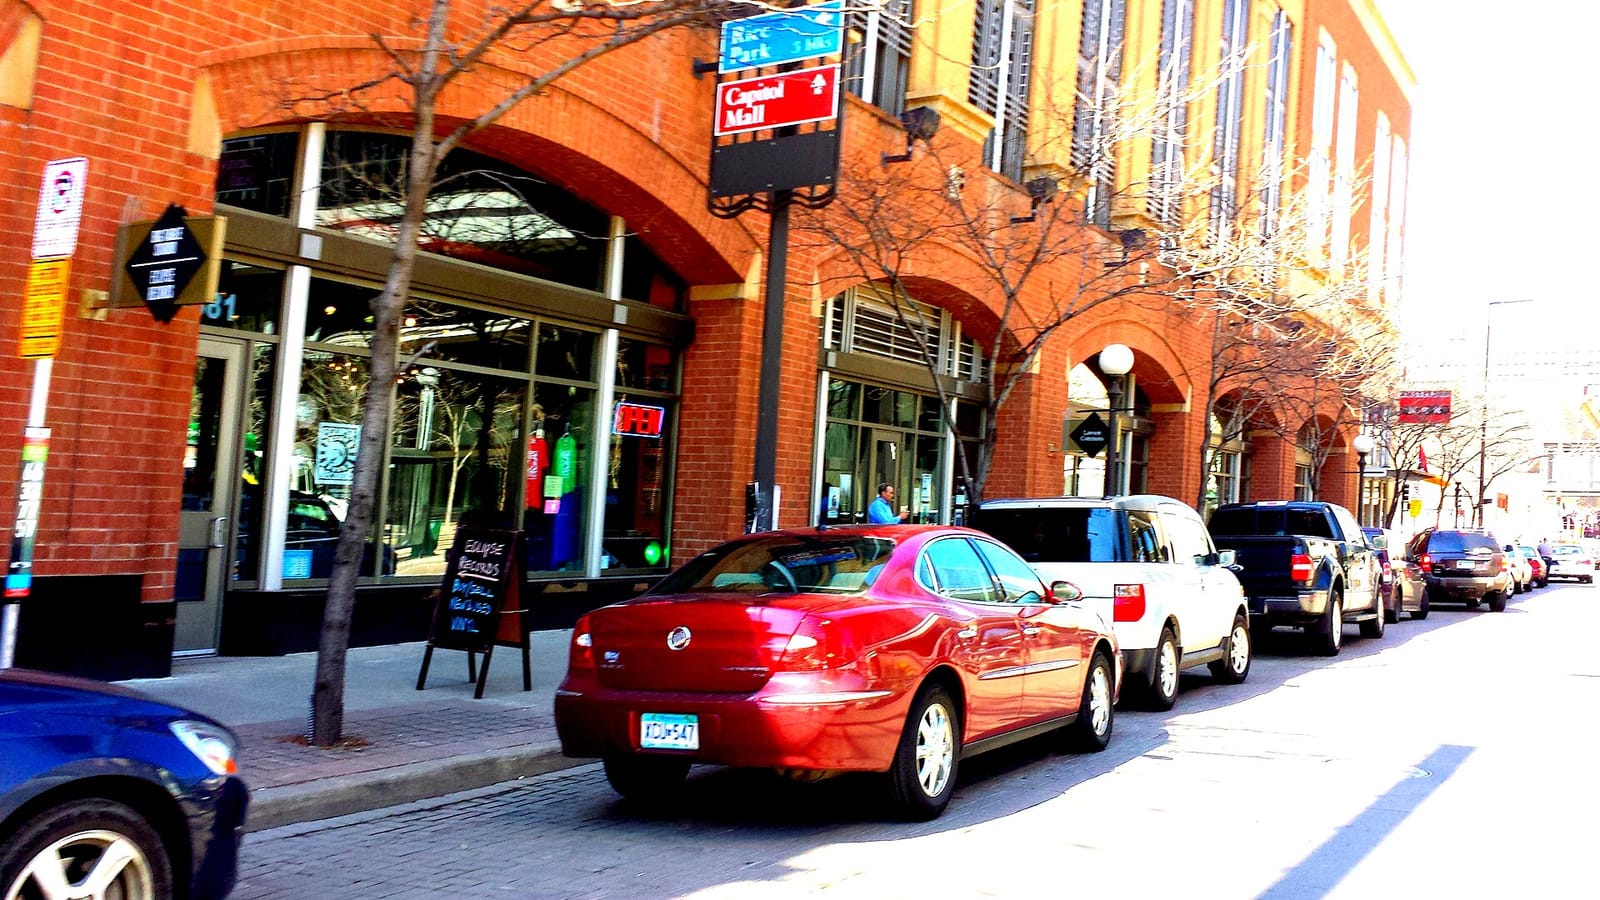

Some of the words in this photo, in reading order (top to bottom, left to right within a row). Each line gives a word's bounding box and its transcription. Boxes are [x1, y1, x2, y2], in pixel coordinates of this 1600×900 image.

[731, 26, 772, 45] Rice
[730, 43, 772, 64] Park
[724, 80, 785, 109] Capitol
[723, 104, 765, 128] Mall
[618, 405, 661, 435] OPEN
[464, 539, 505, 558] ECLIPSE
